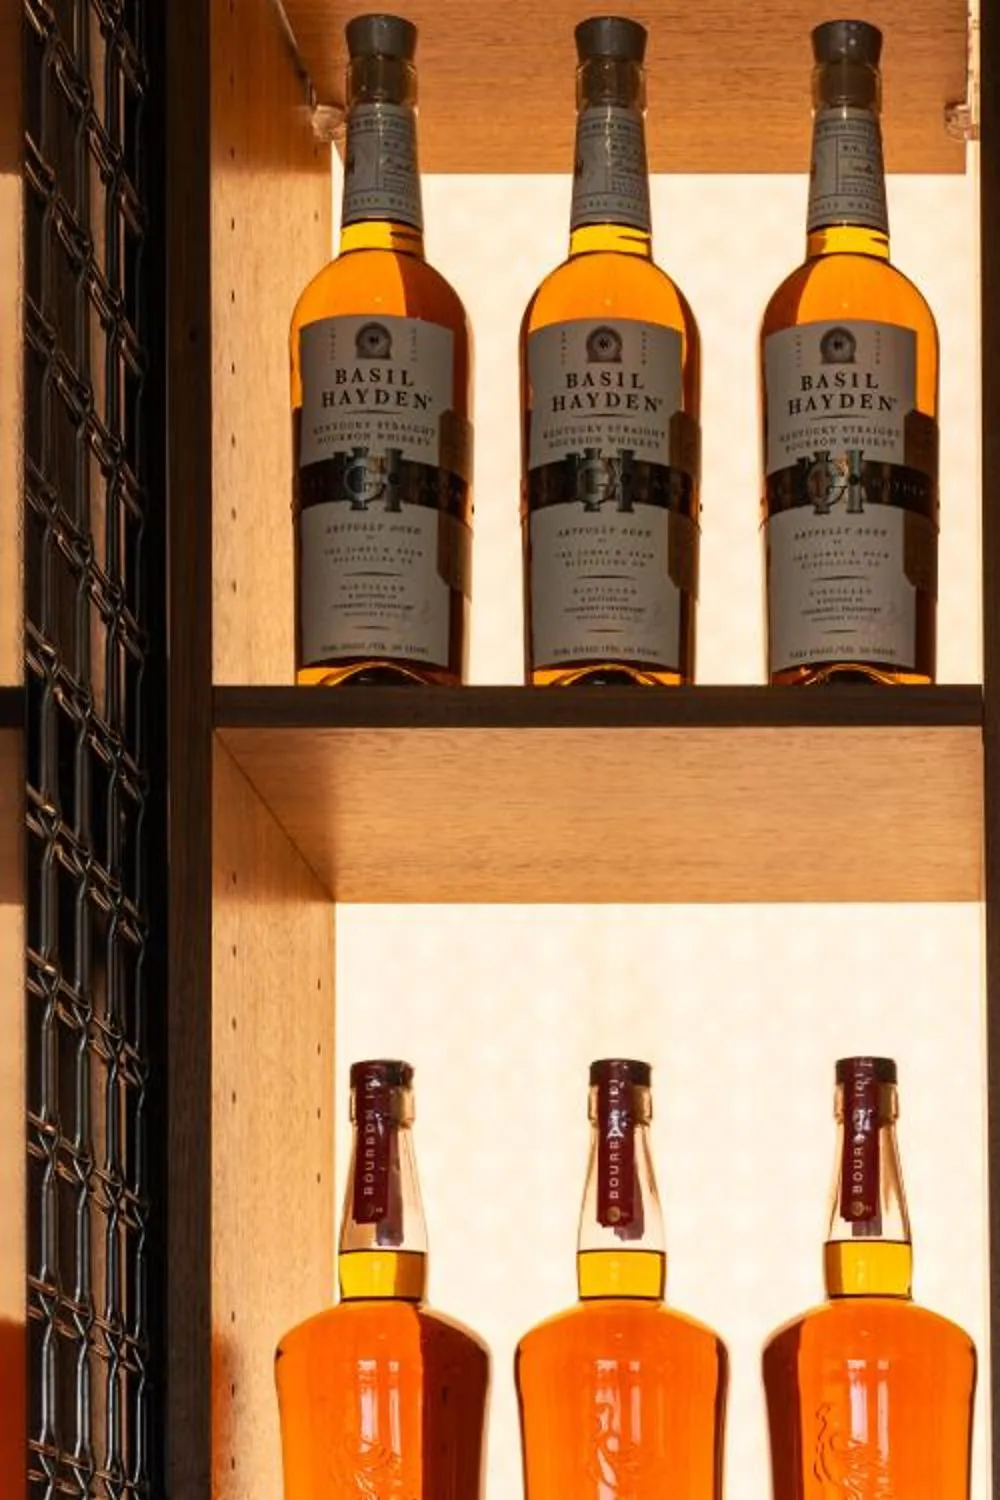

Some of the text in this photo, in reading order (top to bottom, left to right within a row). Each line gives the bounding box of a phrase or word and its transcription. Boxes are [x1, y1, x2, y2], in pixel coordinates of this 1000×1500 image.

[335, 367, 414, 387] BASIL
[565, 371, 645, 389] BASIL
[800, 372, 879, 392] BASIL
